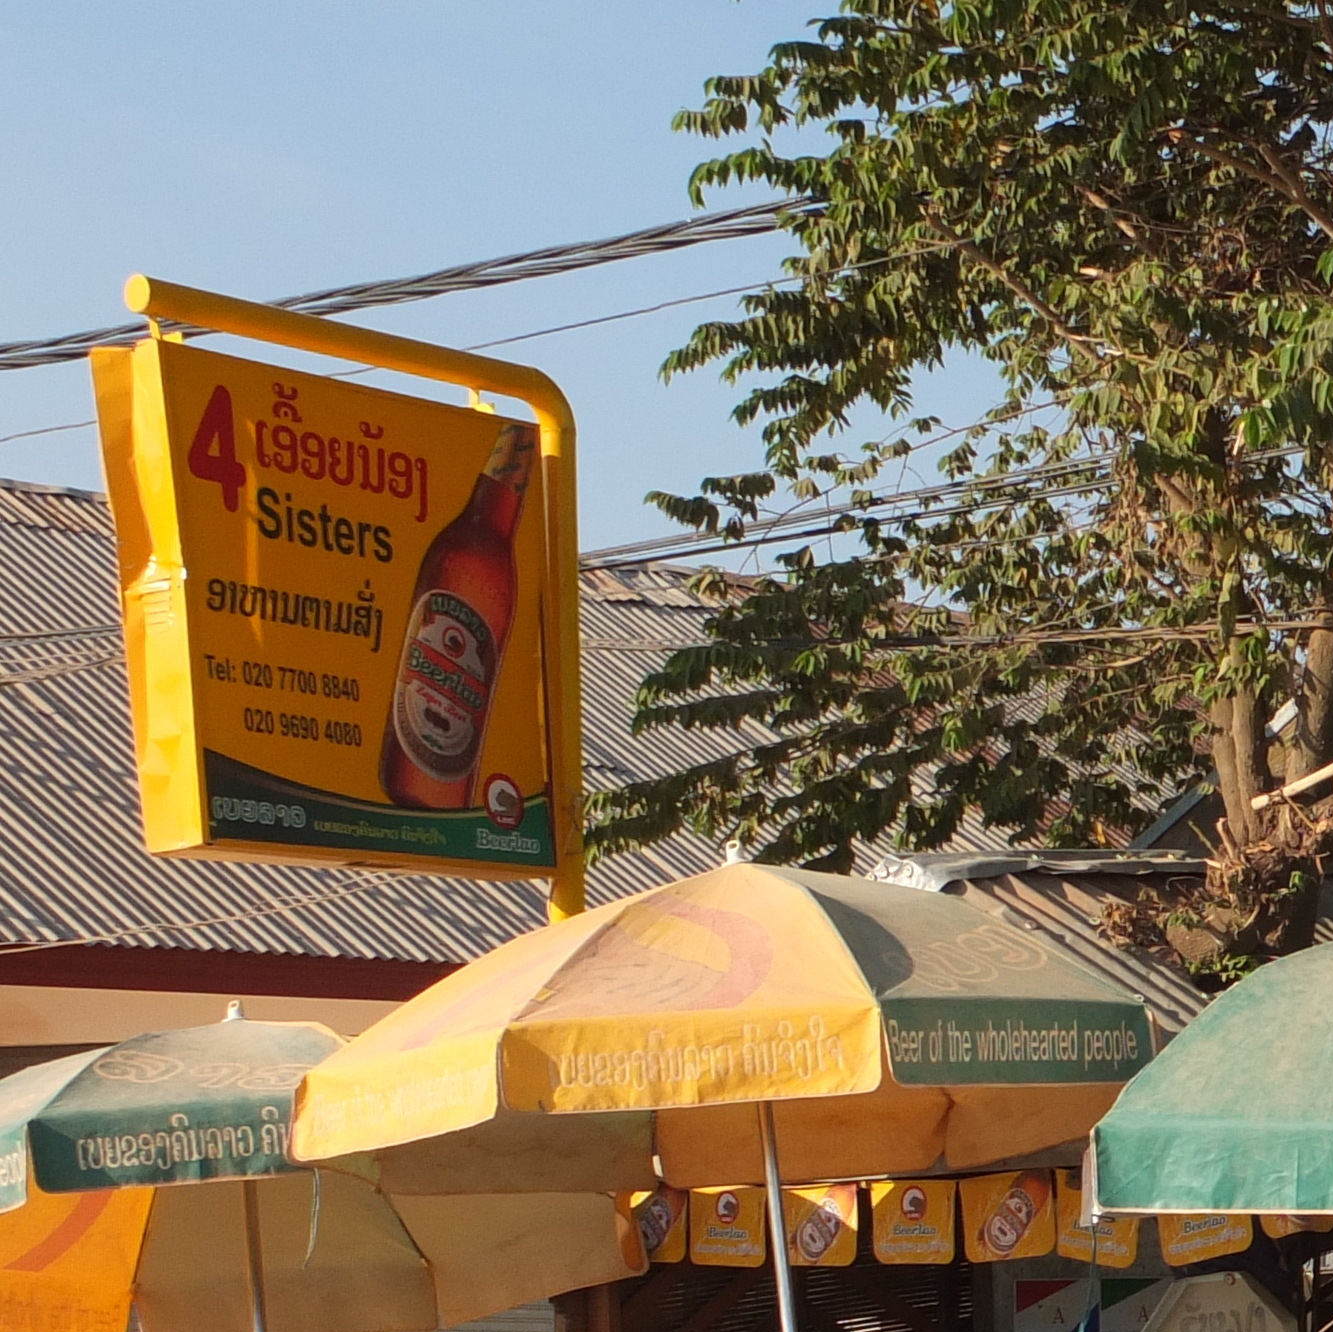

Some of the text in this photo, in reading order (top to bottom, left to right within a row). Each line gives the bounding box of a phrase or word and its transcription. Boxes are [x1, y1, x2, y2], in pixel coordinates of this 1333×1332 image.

[187, 385, 248, 513] 4
[255, 486, 394, 564] Sisters
[203, 653, 361, 703] Tel: 020 7700 8840
[244, 707, 363, 748] 020 9690 4080
[476, 828, 541, 855] Beerlao
[889, 1019, 1138, 1071] Beer of the wholehearted people
[893, 1224, 937, 1236] Beerlao
[1183, 1215, 1227, 1234] Beerlao
[1053, 1306, 1065, 1324] A
